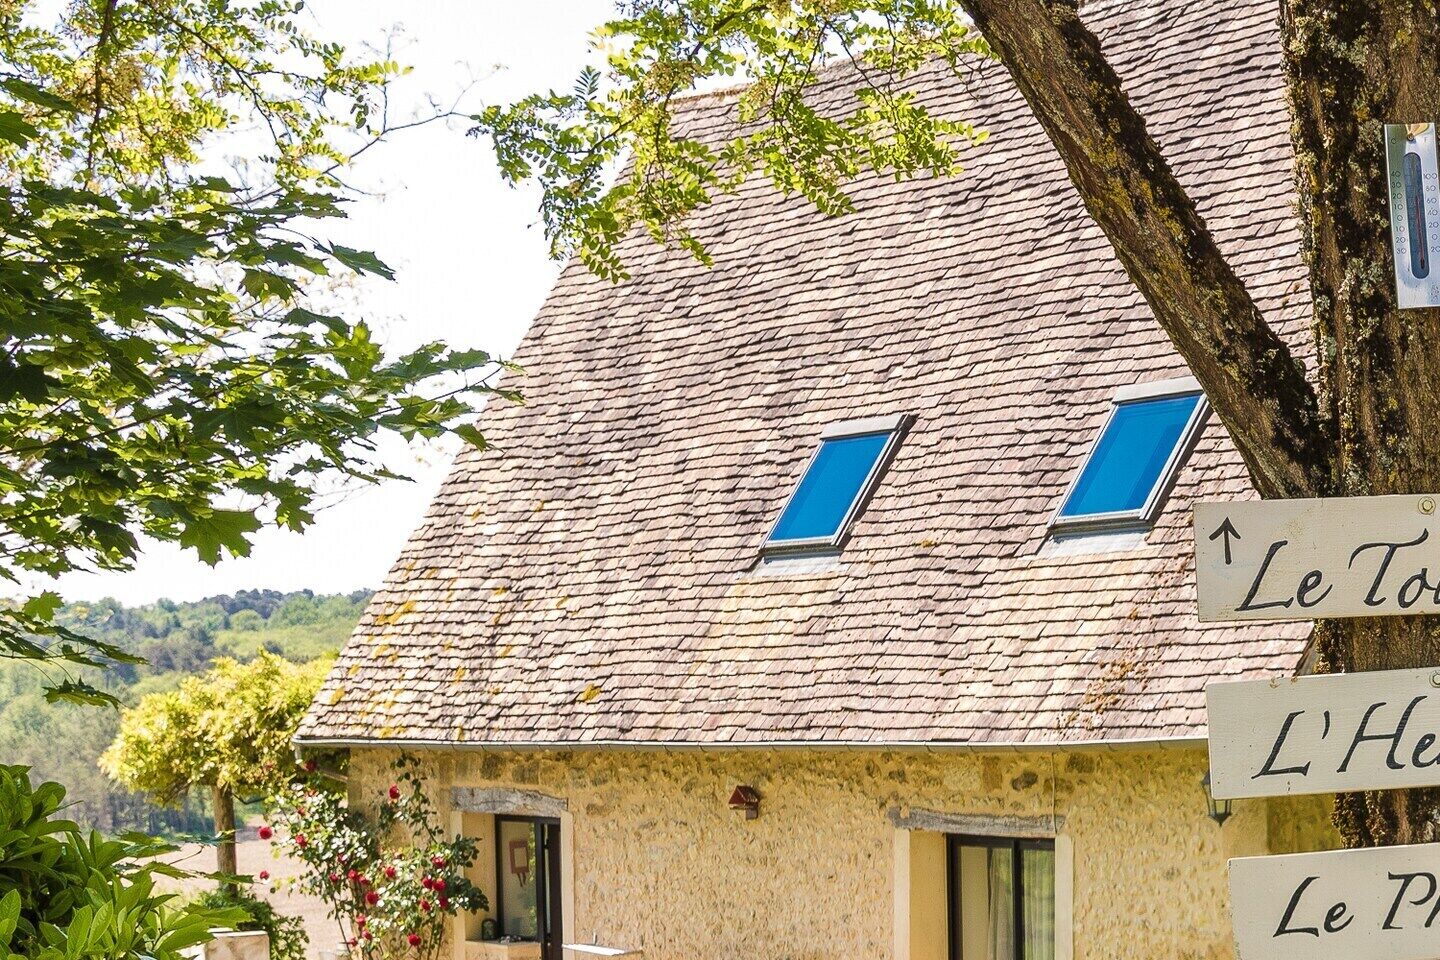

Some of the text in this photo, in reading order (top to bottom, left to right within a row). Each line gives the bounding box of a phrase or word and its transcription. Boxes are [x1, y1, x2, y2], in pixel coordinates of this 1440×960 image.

[1391, 181, 1402, 189] 30
[1392, 192, 1403, 200] 20
[1235, 540, 1333, 612] Le
[1272, 876, 1355, 938] Le
